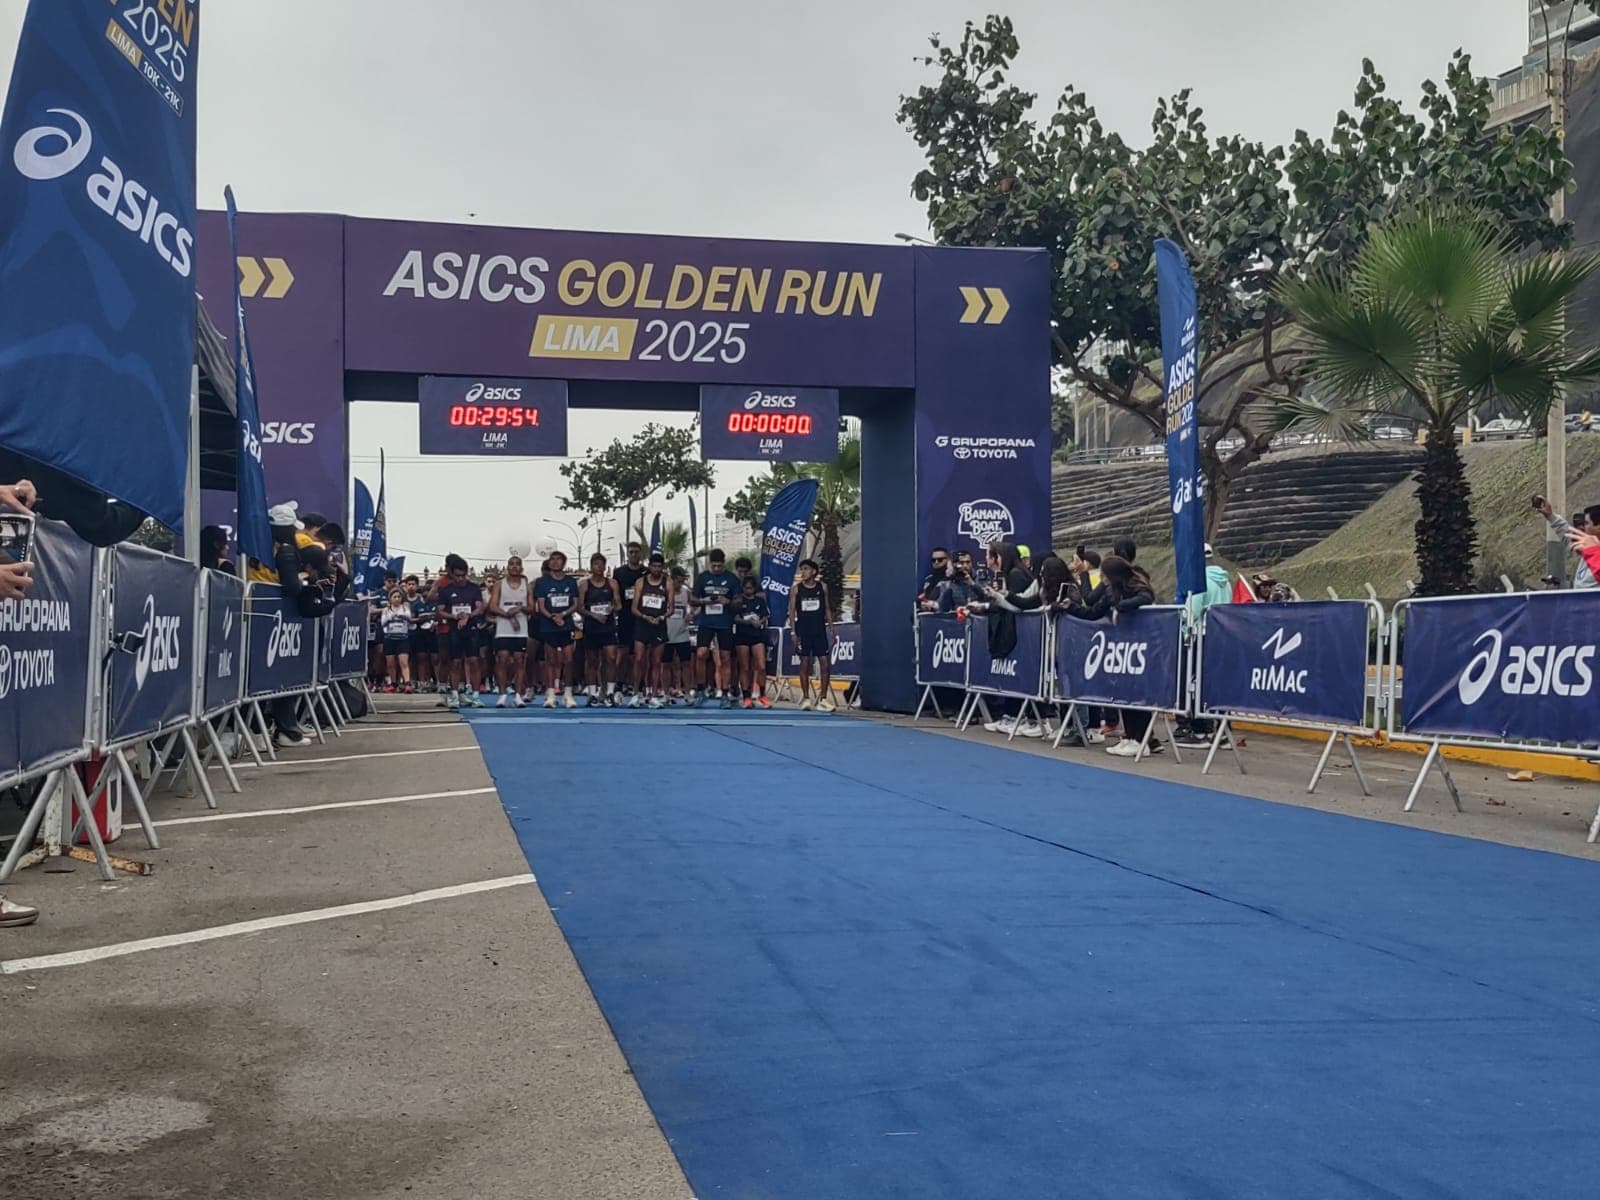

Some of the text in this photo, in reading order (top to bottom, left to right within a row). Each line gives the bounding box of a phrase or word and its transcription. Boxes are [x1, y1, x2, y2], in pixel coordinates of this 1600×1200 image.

[123, 0, 187, 82] 2025
[110, 25, 137, 62] LIMA
[143, 61, 160, 87] 10K
[164, 86, 180, 110] 21K
[86, 155, 194, 278] asics
[382, 250, 883, 317] ASICS GOLDEN RUN
[543, 319, 750, 364] LIMA 2025
[484, 387, 522, 401] asics
[761, 395, 797, 408] asics
[449, 405, 539, 427] 00:29:54
[727, 413, 811, 434] 00:00:00
[1181, 401, 1194, 426] 202
[261, 421, 316, 444] SICS
[482, 432, 508, 443] LIMA
[951, 437, 1036, 447] GRUPOPANA
[759, 438, 784, 449] LIMA
[972, 449, 1018, 459] TOYOTA
[961, 505, 1008, 522] BANANA
[767, 526, 803, 546] ASICS
[970, 520, 1002, 536] BOAT
[764, 536, 799, 554] GOLDEN
[990, 658, 1017, 677] RIMAC
[1103, 641, 1148, 675] asics
[13, 648, 55, 690] TOYOTA
[1250, 664, 1309, 694] RIMAC
[1501, 645, 1596, 697] asics
